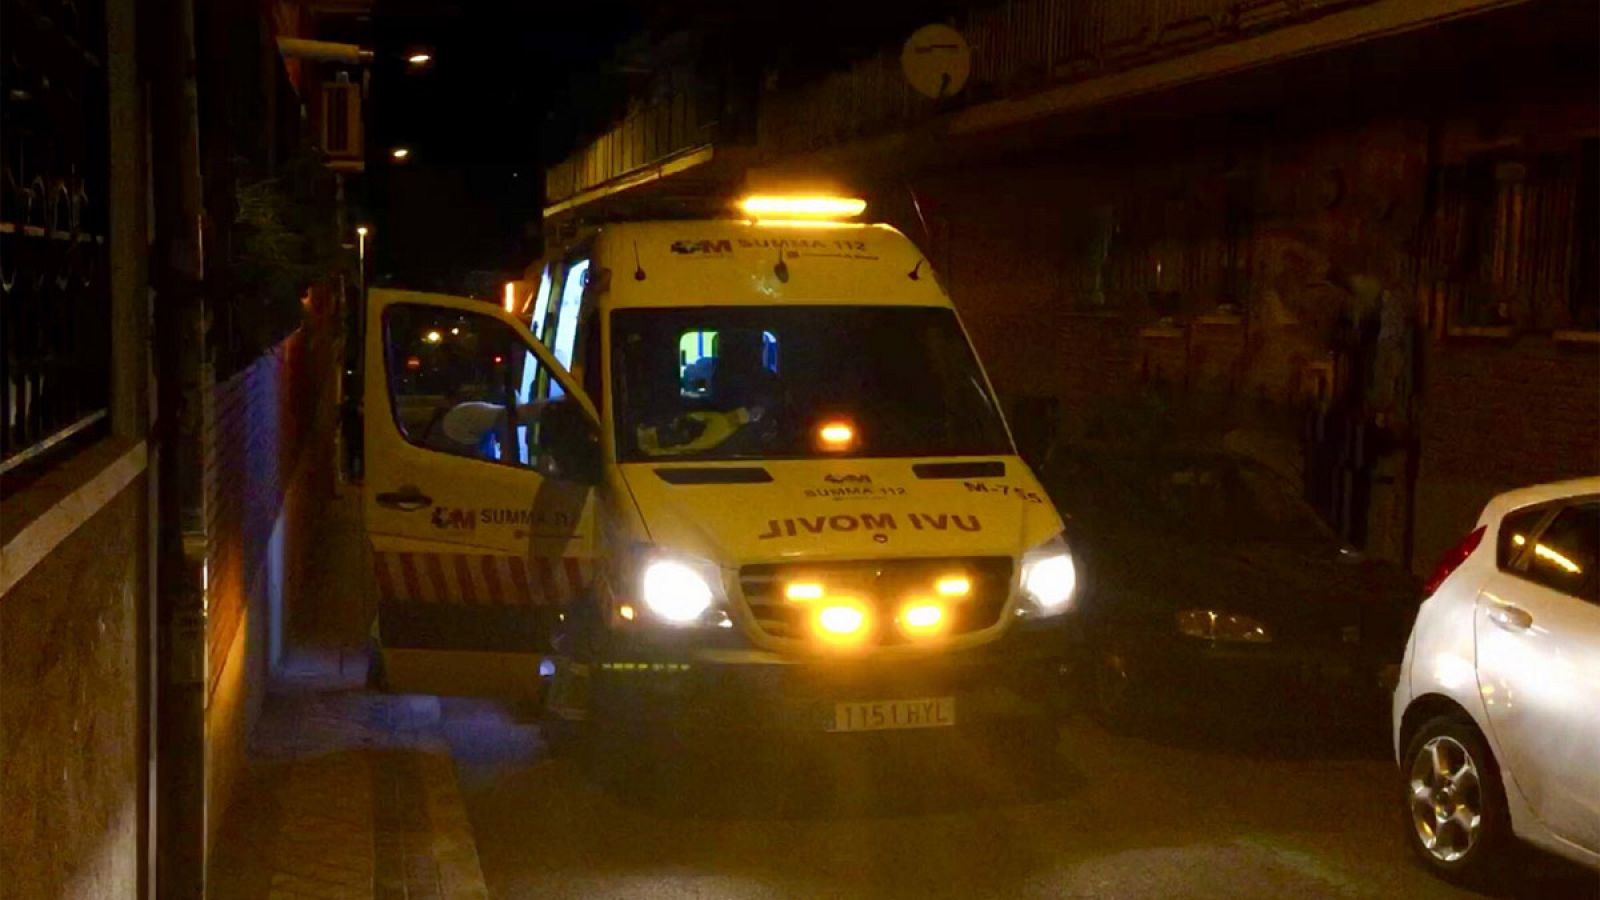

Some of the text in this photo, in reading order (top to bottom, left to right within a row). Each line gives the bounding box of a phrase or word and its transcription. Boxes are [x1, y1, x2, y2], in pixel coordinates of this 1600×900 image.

[737, 239, 825, 249] SUMMA
[833, 240, 866, 251] 112
[803, 486, 906, 497] SUMMA 112
[844, 701, 948, 731] 1151 HYL
